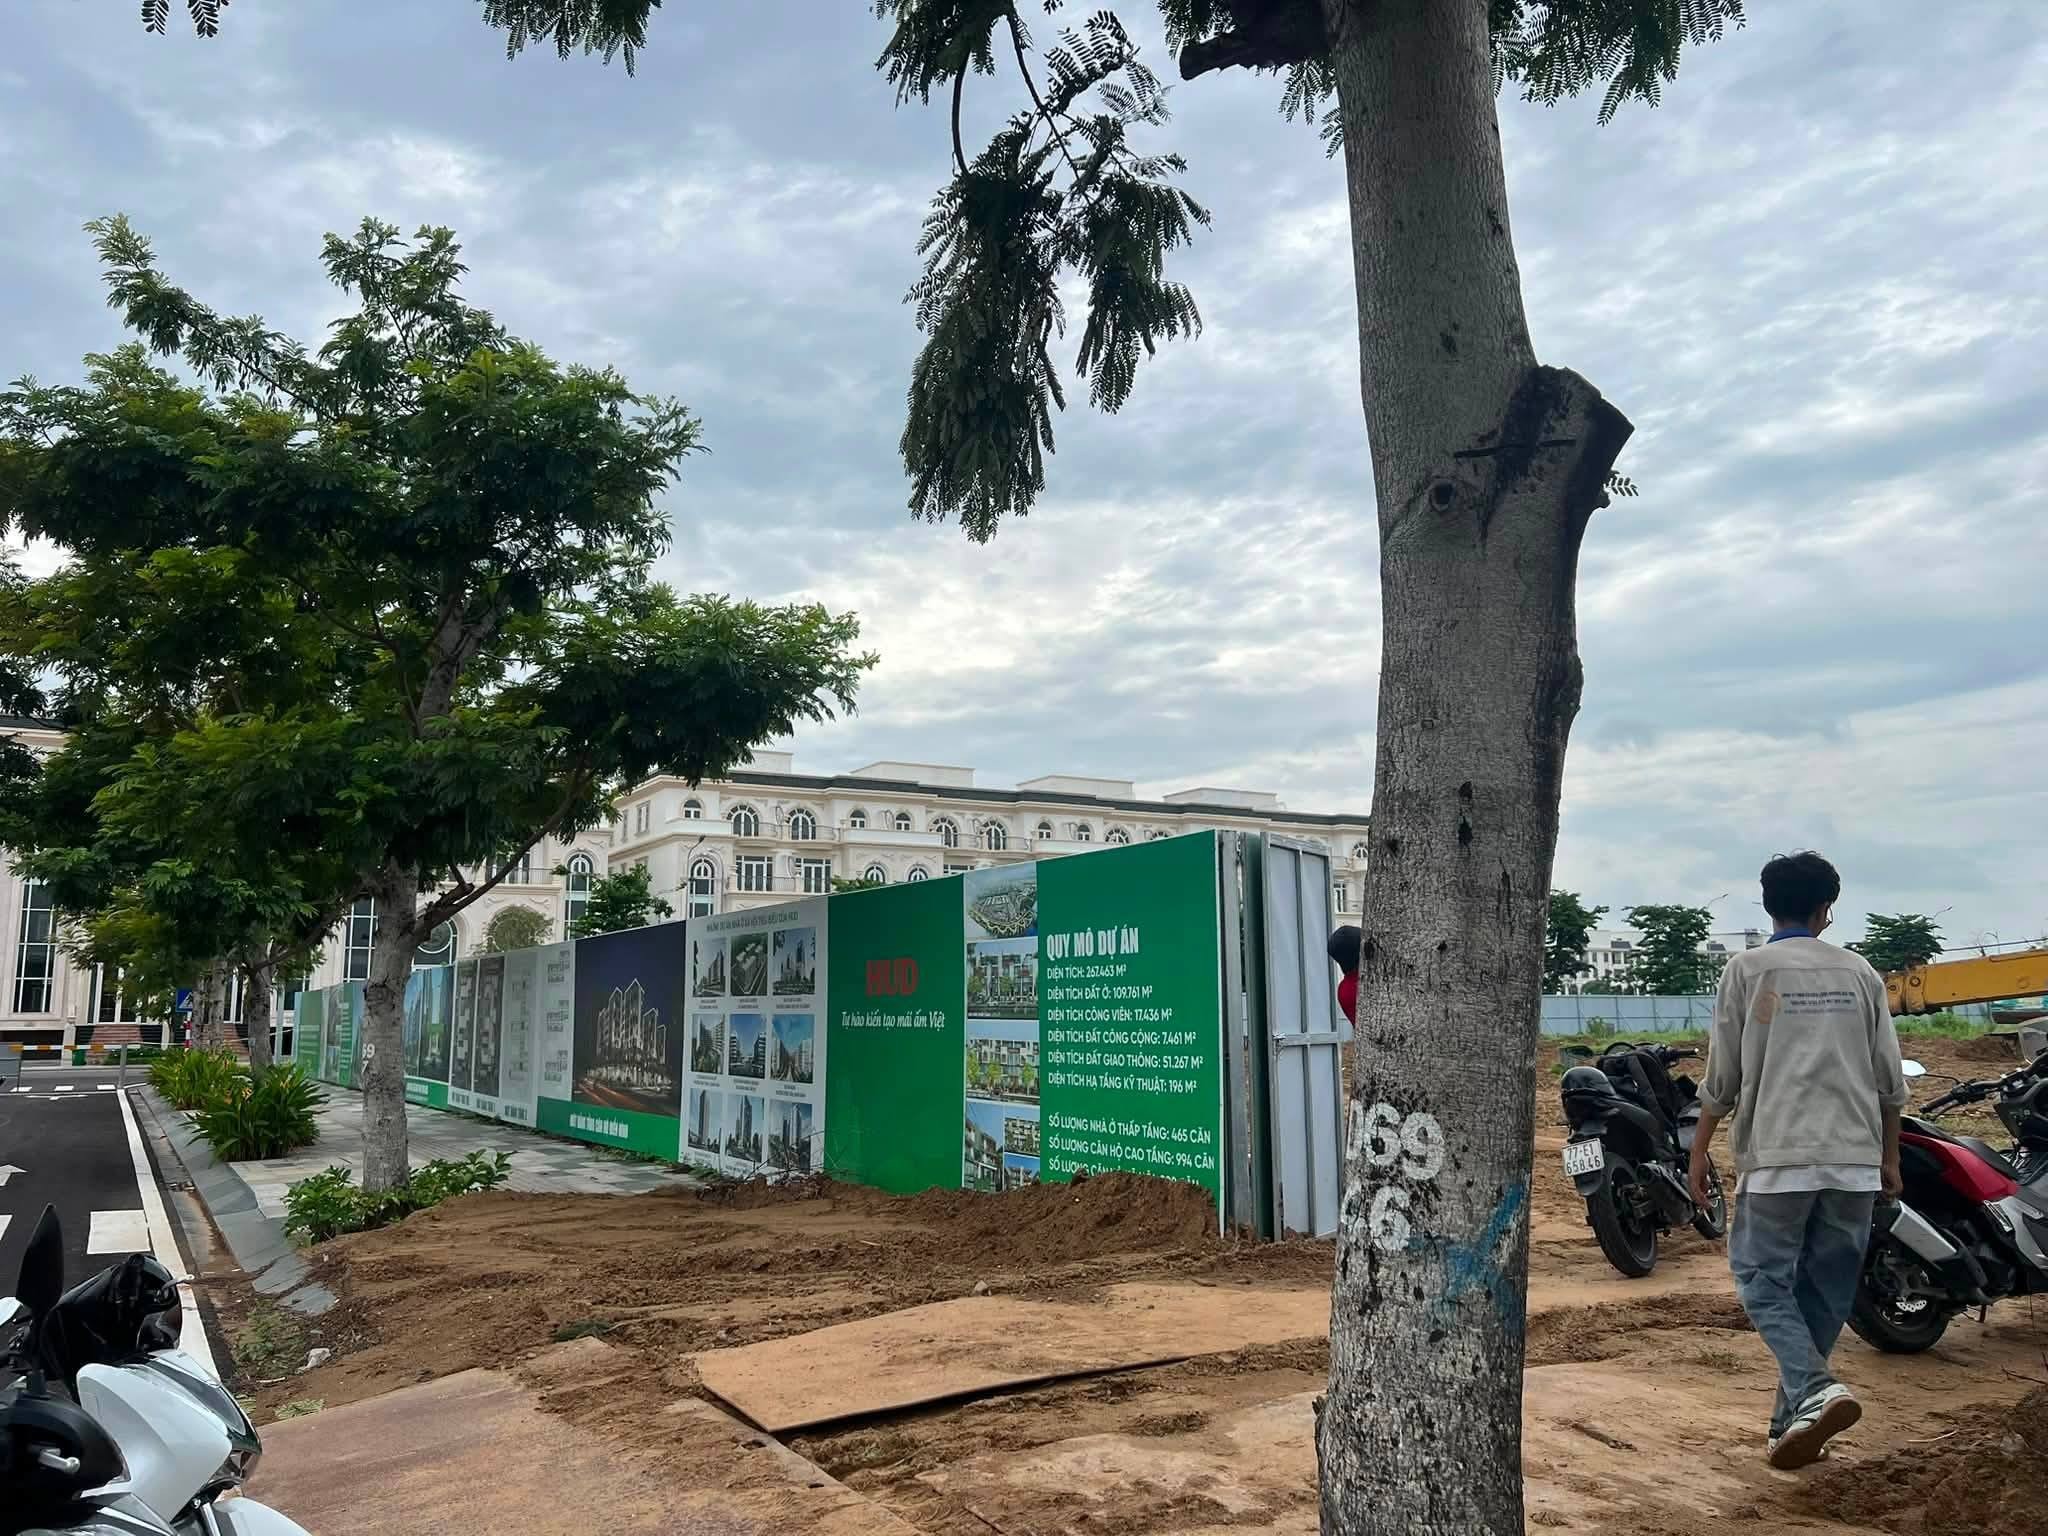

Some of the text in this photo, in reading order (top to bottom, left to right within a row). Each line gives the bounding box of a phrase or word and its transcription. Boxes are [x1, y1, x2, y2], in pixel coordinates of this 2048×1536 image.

[1046, 924, 1139, 961] QUY MÔ DỰ ÁN
[865, 957, 919, 998] HUD
[1047, 964, 1064, 982] DIỆN
[1065, 964, 1085, 979] TÍCH:
[1115, 964, 1127, 977] M²
[1047, 985, 1064, 1003] DIỆN
[1065, 985, 1083, 1000] TÍCH
[1085, 984, 1100, 1000] ĐẤT
[1113, 986, 1140, 1000] 109.761
[1141, 985, 1153, 999] M²
[841, 1009, 945, 1032] Tự hào kiến tạo mái ấm Việt
[1047, 1006, 1173, 1024] DIỆN TÍCH CÔNG VIÊN: 17.436 M²
[1047, 1027, 1197, 1048] DIỆN TÍCH ĐẤT CÔNG CỘNG: 7.461 M²
[1047, 1048, 1204, 1069] DIỆN TÍCH ĐẤT GIAO THÔNG: 51.267 M²
[1048, 1070, 1066, 1088] DIỆN
[1066, 1070, 1085, 1087] TÍCH
[1085, 1074, 1098, 1091] HẠ
[1135, 1075, 1167, 1095] THUẬT:
[1168, 1079, 1183, 1093] 196
[1185, 1079, 1197, 1093] M²
[1048, 1111, 1060, 1128] SỐ
[1061, 1116, 1088, 1133] LƯỢNG
[1089, 1117, 1108, 1134] NHÀ
[1117, 1119, 1140, 1137] THẤP
[1171, 1127, 1188, 1142] 465
[1189, 1127, 1211, 1144] CĂN
[1048, 1132, 1060, 1150] SỐ
[1061, 1137, 1089, 1155] LƯỢNG
[1090, 1140, 1108, 1157] CĂN
[1109, 1142, 1123, 1161] HỘ
[1124, 1145, 1145, 1161] CAO
[1175, 1152, 1193, 1168] 994
[1194, 1152, 1215, 1170] CĂN
[1566, 1143, 1594, 1161] 77-E1
[1048, 1154, 1060, 1171] SỐ
[1566, 1155, 1601, 1174] 658.46
